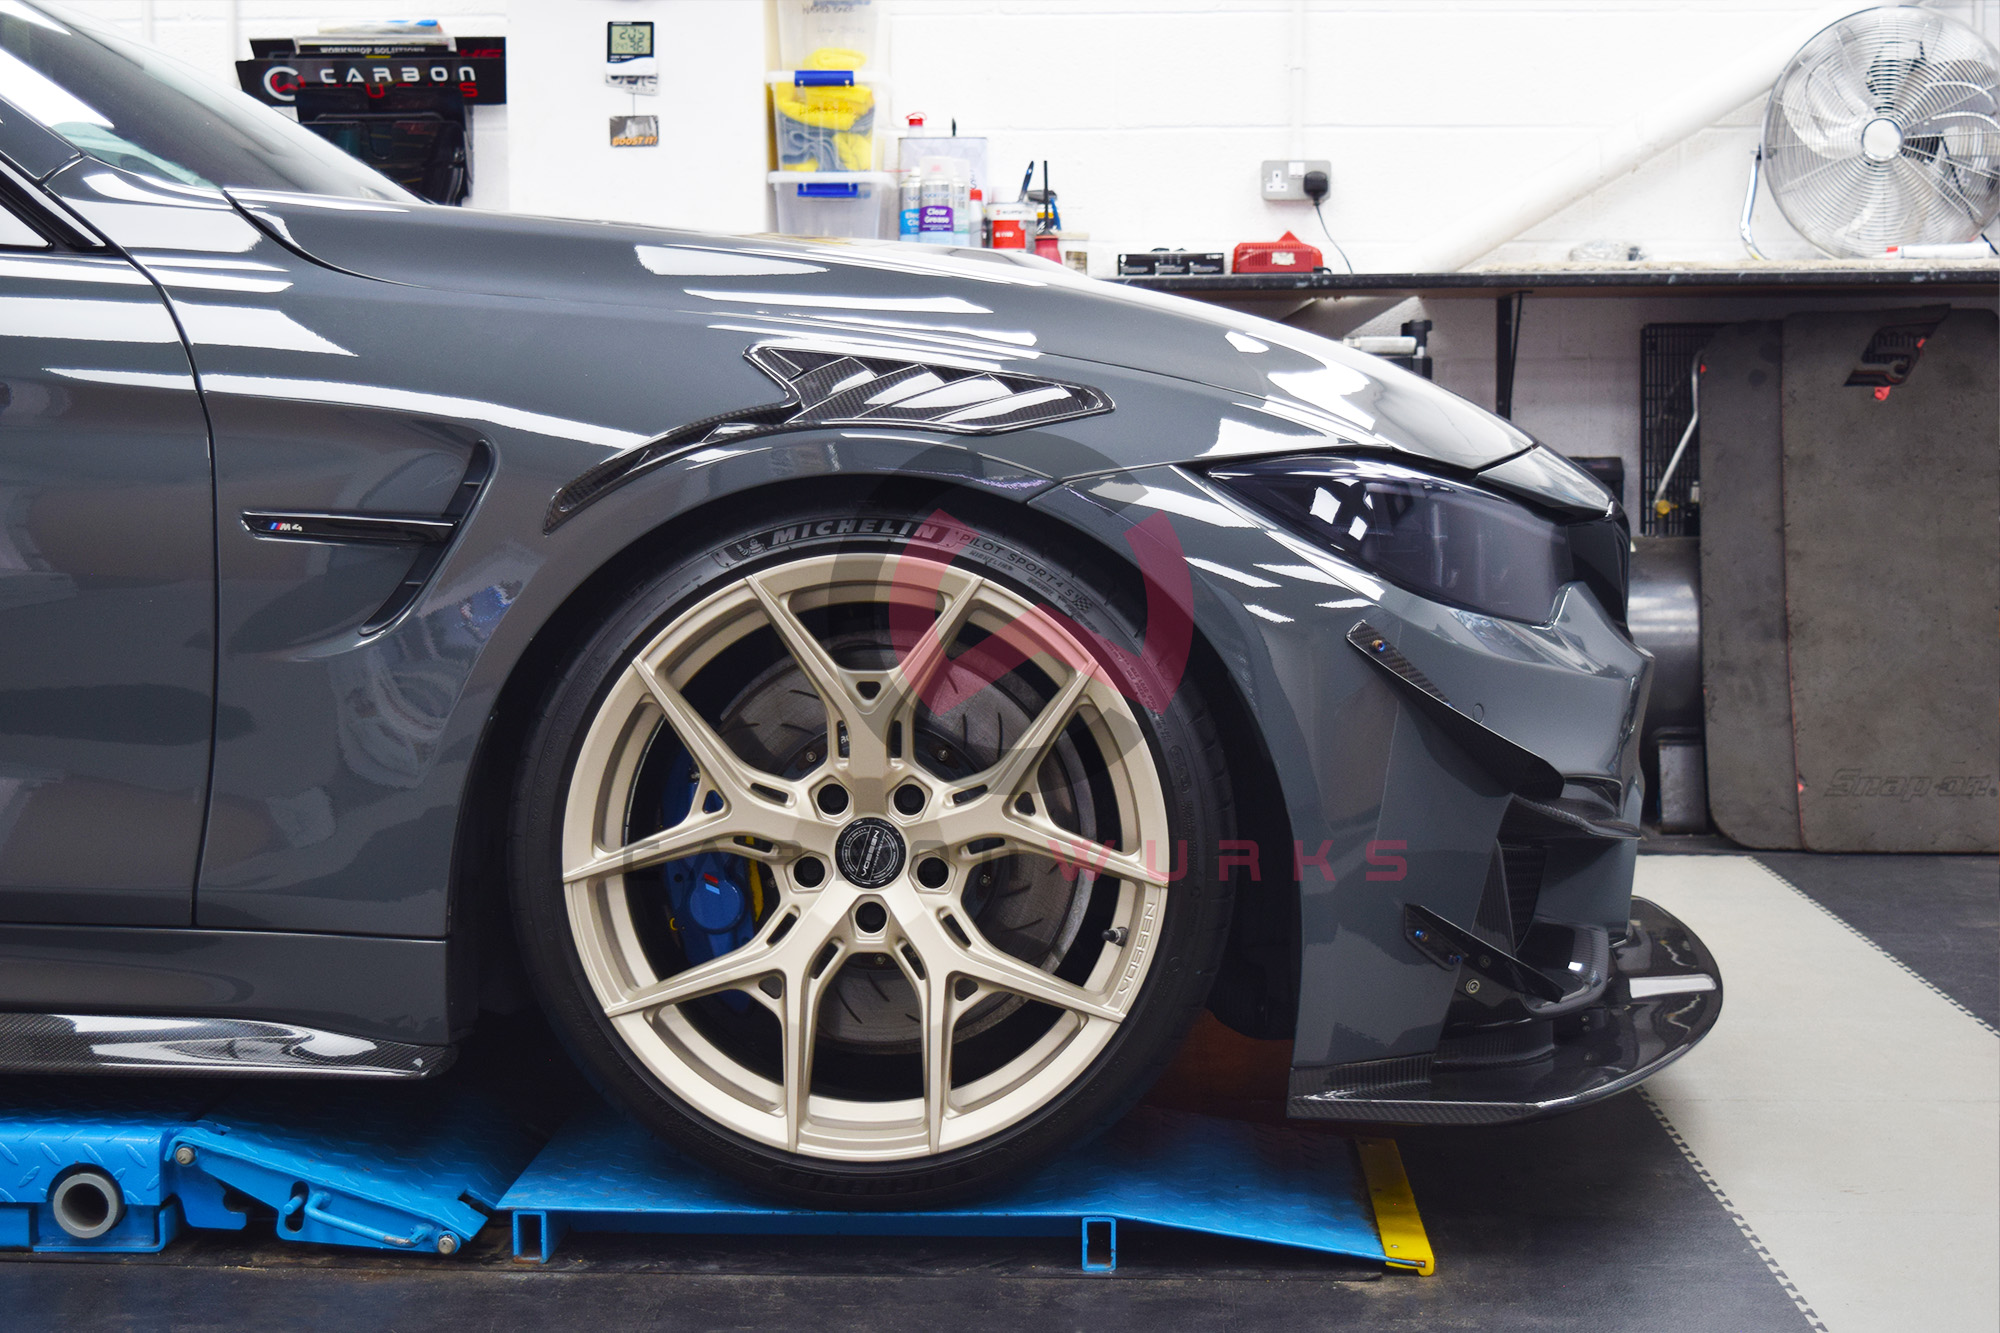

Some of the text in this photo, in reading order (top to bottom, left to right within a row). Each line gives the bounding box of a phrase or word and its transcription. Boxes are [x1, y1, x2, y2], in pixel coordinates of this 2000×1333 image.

[320, 66, 476, 84] CARBON
[926, 207, 948, 216] Clear
[924, 216, 951, 224] Grease
[279, 523, 303, 532] M4
[772, 519, 940, 546] MICHELIN
[959, 534, 1005, 555] PILOT
[1007, 553, 1057, 583] SPORT
[1055, 578, 1063, 588] 4
[1118, 902, 1156, 995] VOSSEN
